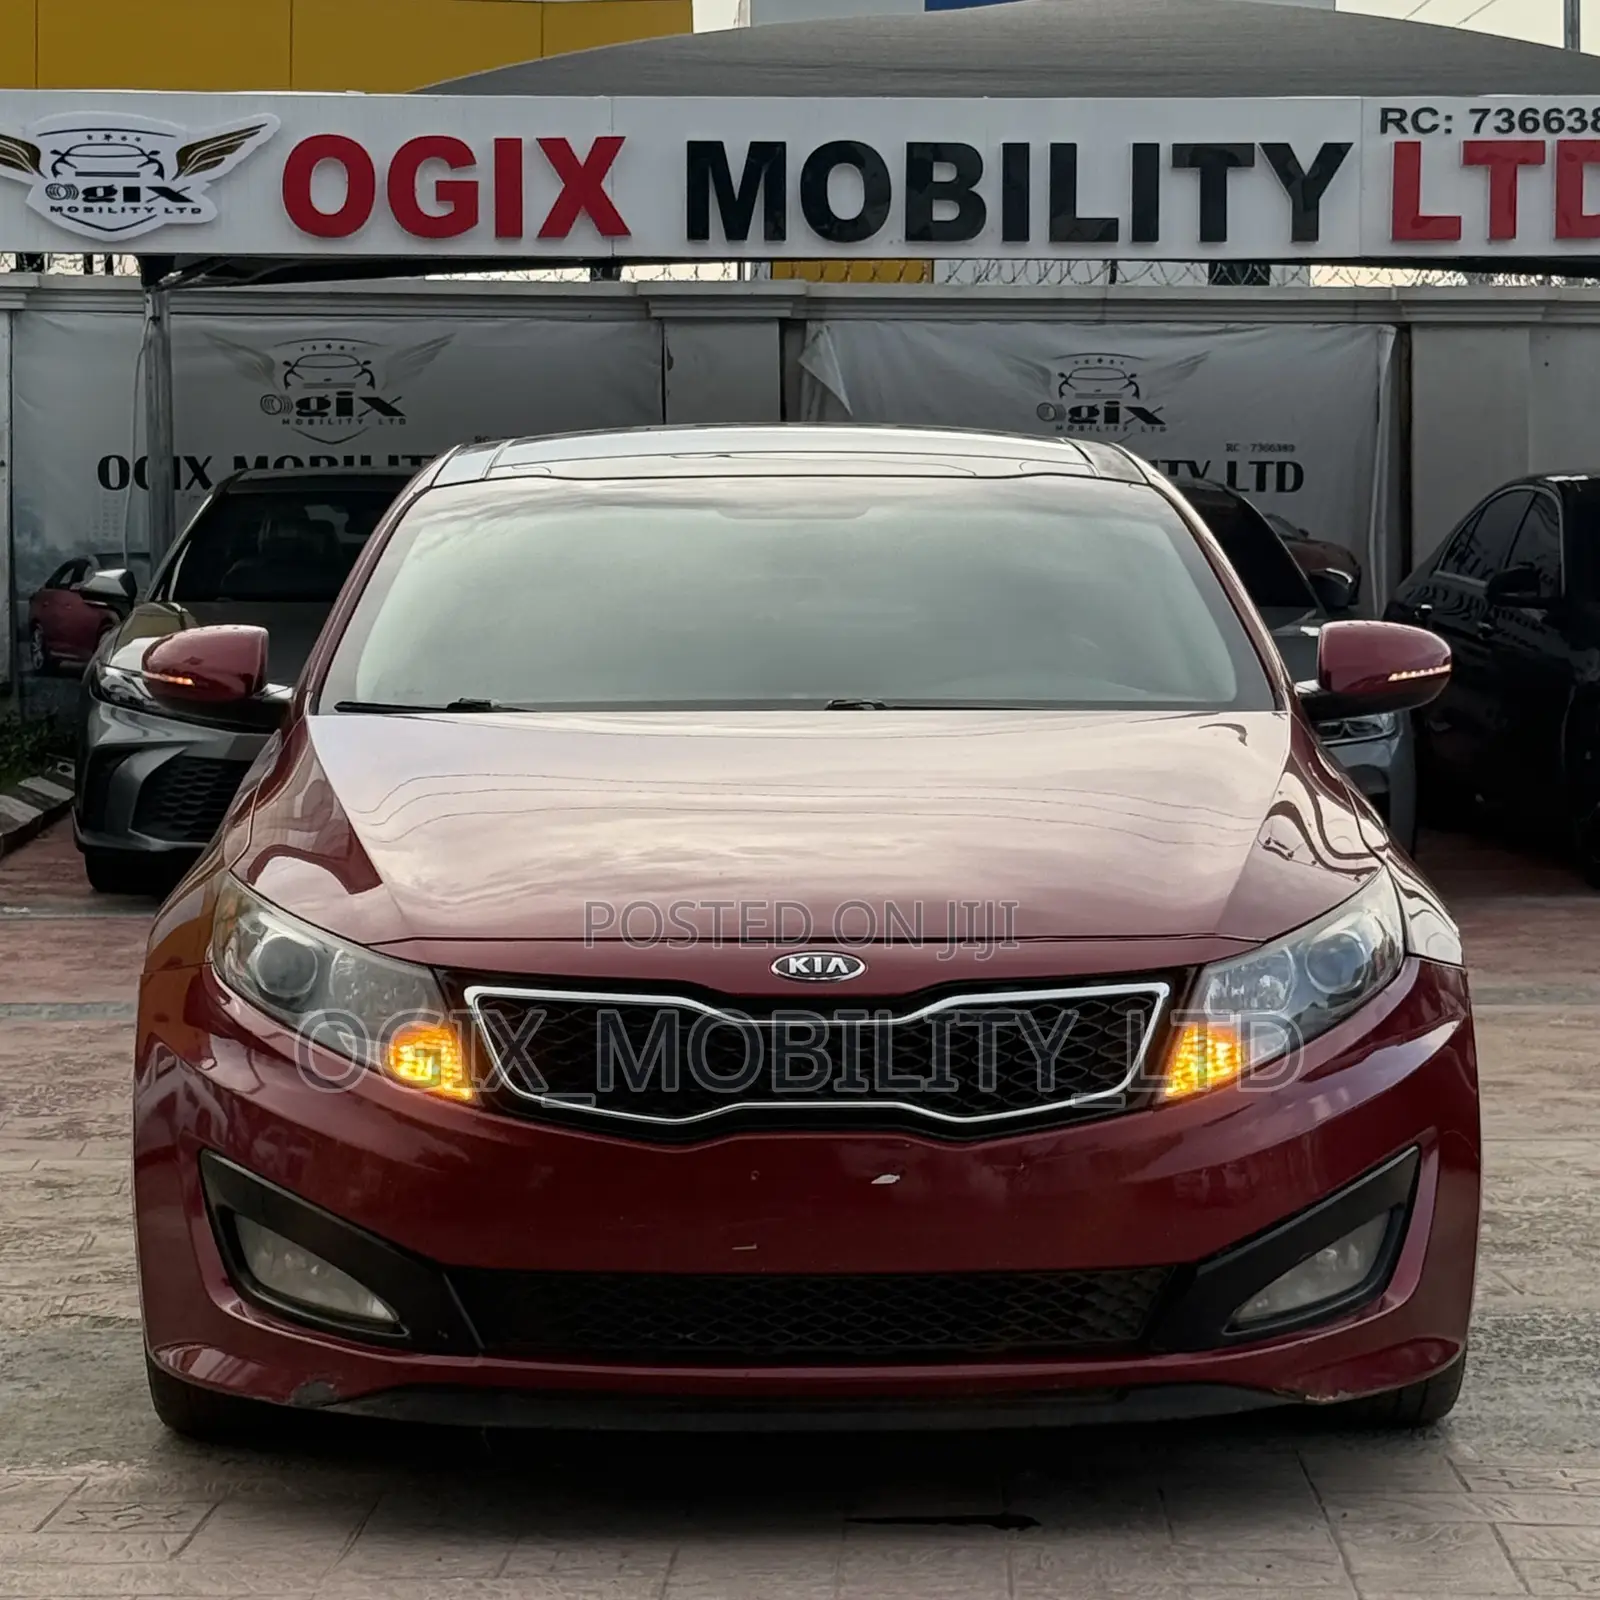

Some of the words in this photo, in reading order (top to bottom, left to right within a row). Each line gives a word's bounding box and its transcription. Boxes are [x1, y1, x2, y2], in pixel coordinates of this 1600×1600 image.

[1380, 107, 1453, 134] RC:
[282, 133, 632, 239] OGIX
[686, 140, 1353, 243] MOBILITY
[50, 206, 155, 214] MOBILITY
[164, 207, 202, 215] LTD
[282, 418, 364, 426] MOBILITY
[378, 418, 407, 426] LTD
[1226, 460, 1304, 493] LTD
[788, 957, 850, 974] KIA
